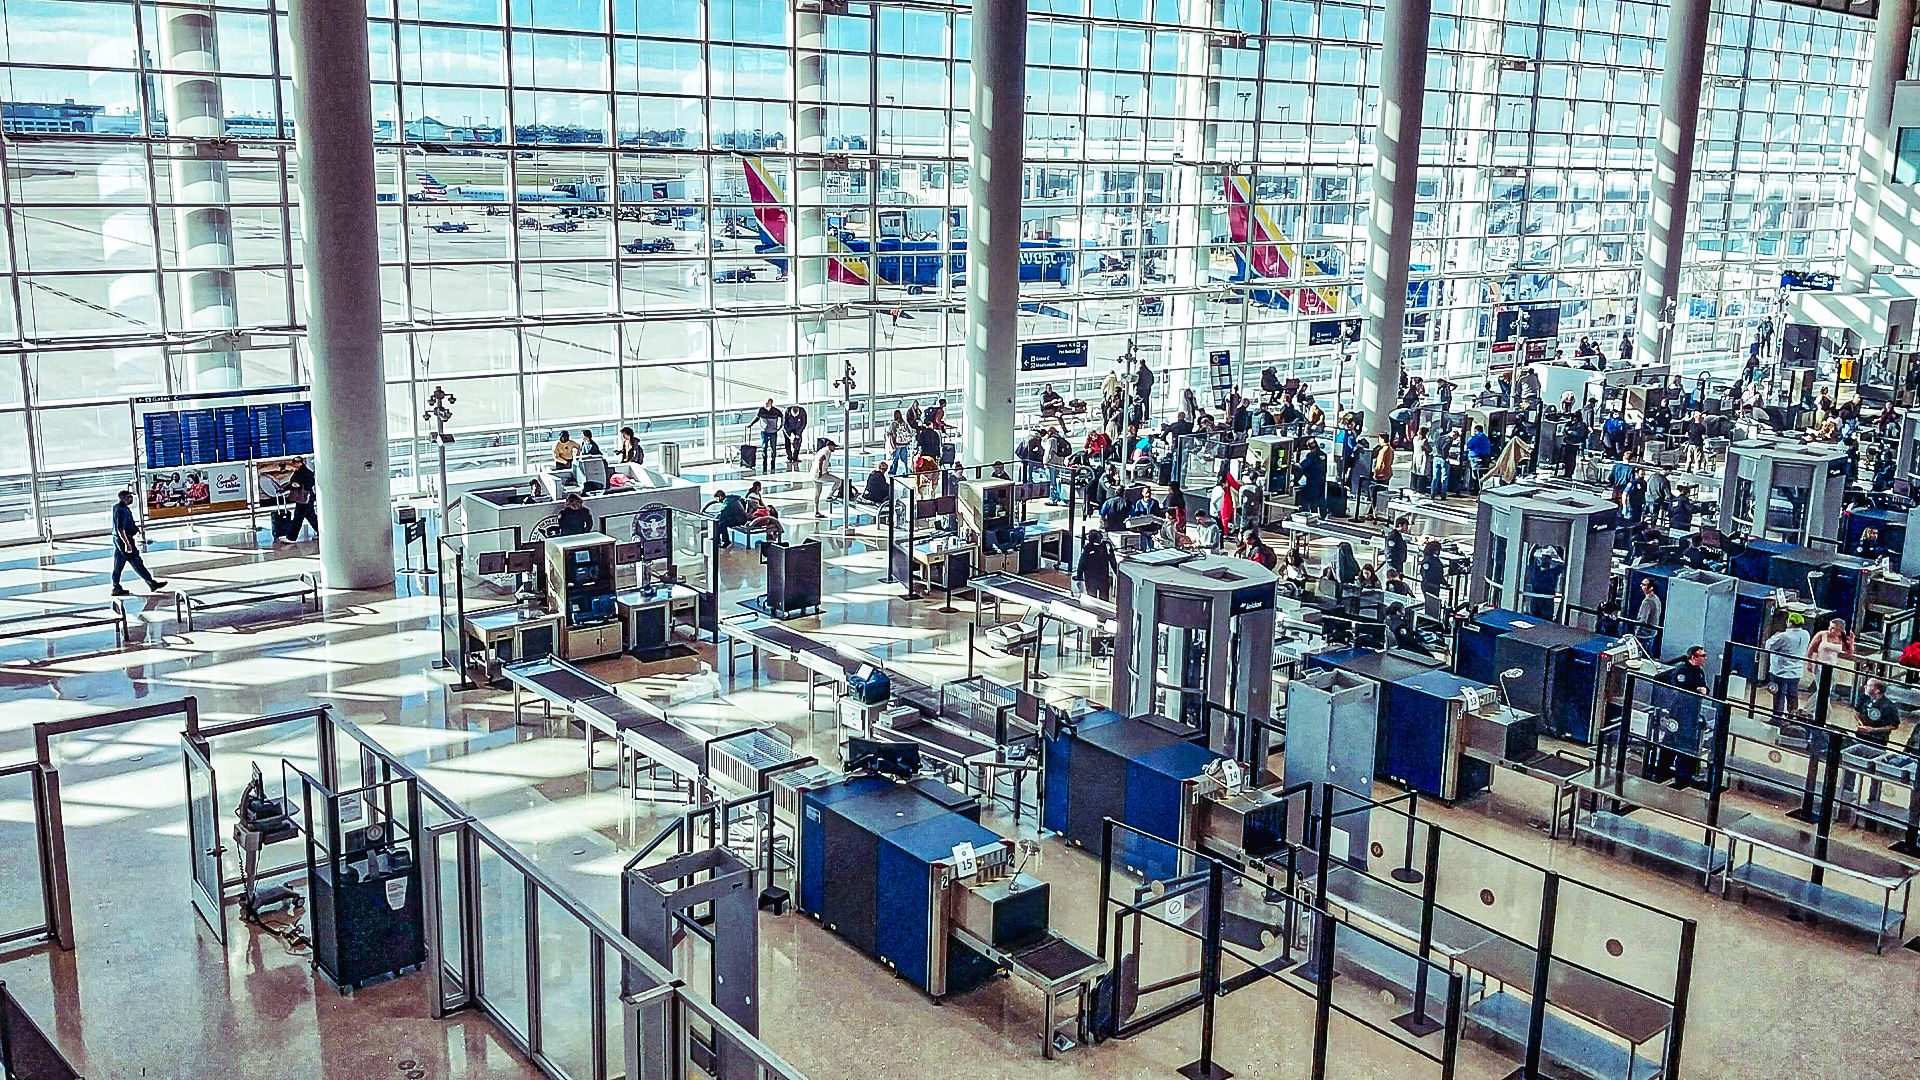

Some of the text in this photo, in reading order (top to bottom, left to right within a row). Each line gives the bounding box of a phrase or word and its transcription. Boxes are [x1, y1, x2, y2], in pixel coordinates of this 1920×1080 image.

[1229, 771, 1238, 782] 14
[961, 858, 973, 871] 15
[1008, 853, 1015, 867] 2
[941, 875, 948, 889] 2
